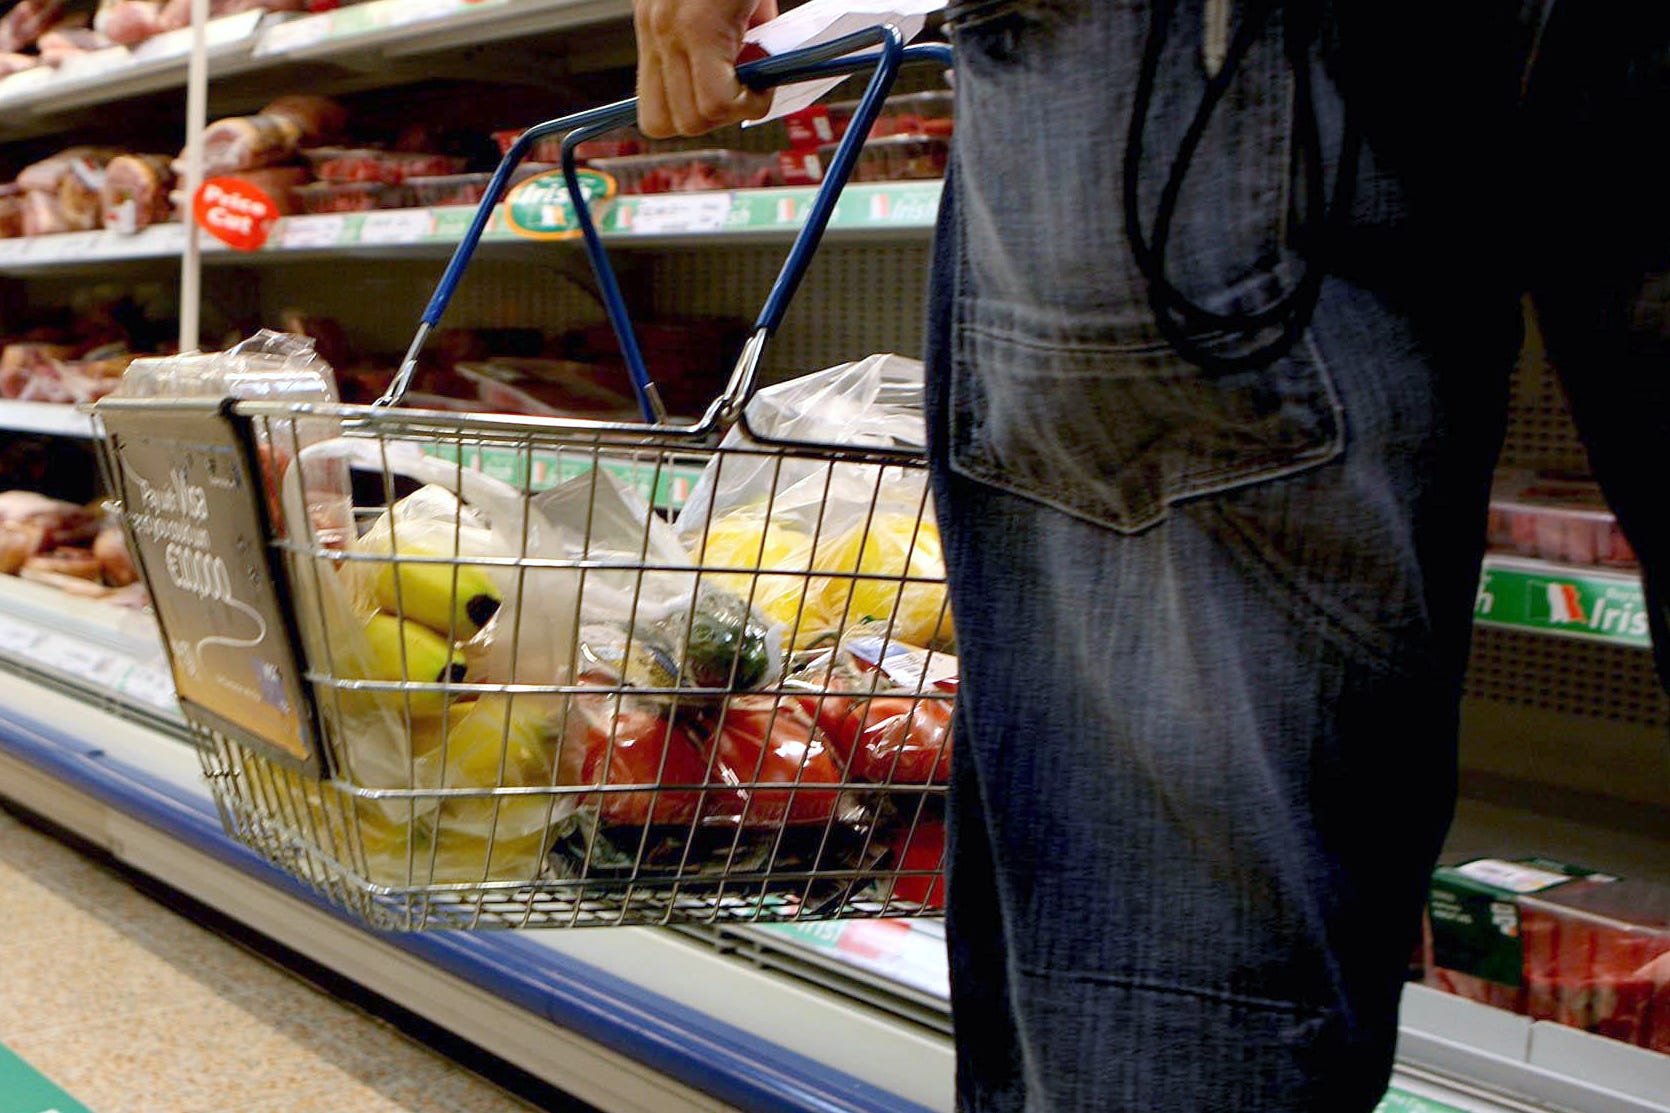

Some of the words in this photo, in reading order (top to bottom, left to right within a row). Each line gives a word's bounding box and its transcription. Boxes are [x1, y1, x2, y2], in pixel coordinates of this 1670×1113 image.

[203, 184, 267, 217] Price
[206, 206, 253, 236] Cut
[1588, 597, 1649, 636] Iris
